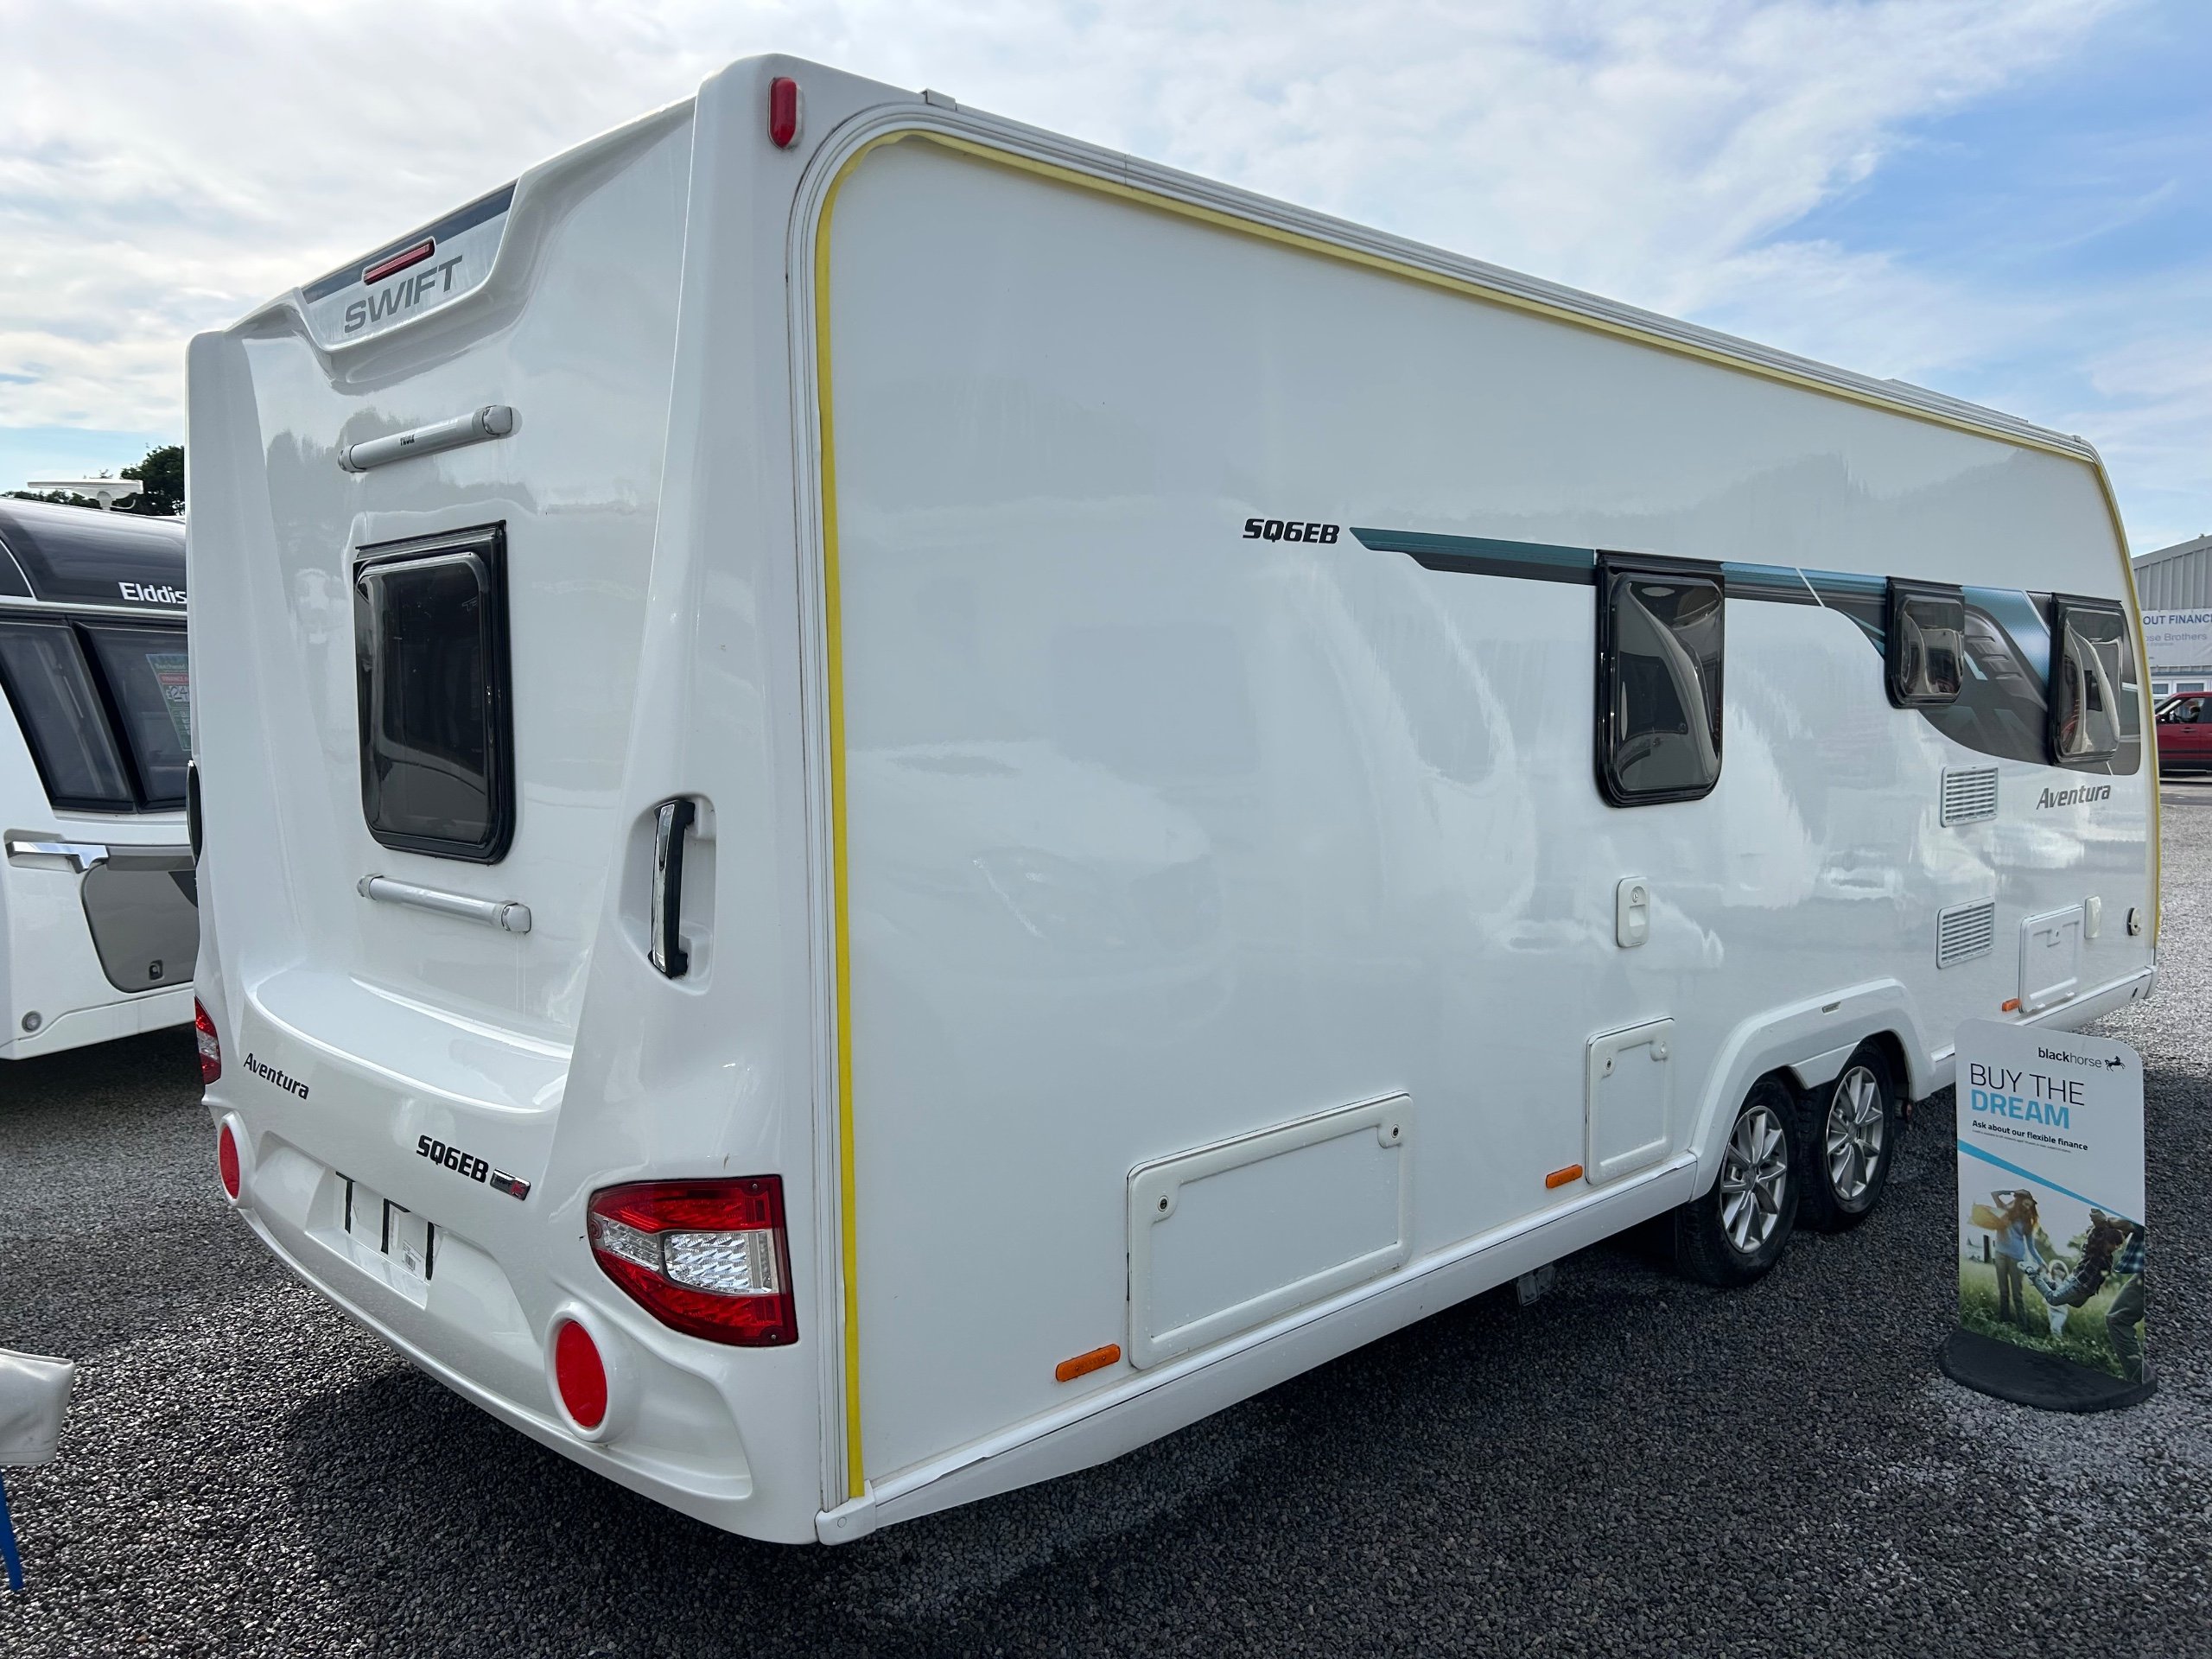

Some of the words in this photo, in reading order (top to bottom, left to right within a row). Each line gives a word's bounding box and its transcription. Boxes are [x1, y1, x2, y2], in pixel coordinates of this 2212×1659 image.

[344, 256, 463, 334] SWIFT
[1243, 518, 1340, 544] SQ6EB
[118, 582, 188, 604] Elddis
[2142, 615, 2166, 626] OUT
[2168, 613, 2212, 625] FINANC
[2164, 632, 2208, 641] Brothers
[2036, 785, 2111, 810] Aventura
[2037, 1046, 2102, 1069] blackhorse
[243, 1052, 309, 1100] Aventura
[1970, 1063, 2023, 1093] BUY
[2029, 1073, 2085, 1107] THE
[1971, 1089, 2070, 1130] DREAM
[1972, 1120, 1986, 1129] Ask
[1987, 1122, 2011, 1135] about
[2026, 1131, 2056, 1144] flexible
[2057, 1137, 2088, 1151] finance
[416, 1135, 489, 1184] SQ6EB
